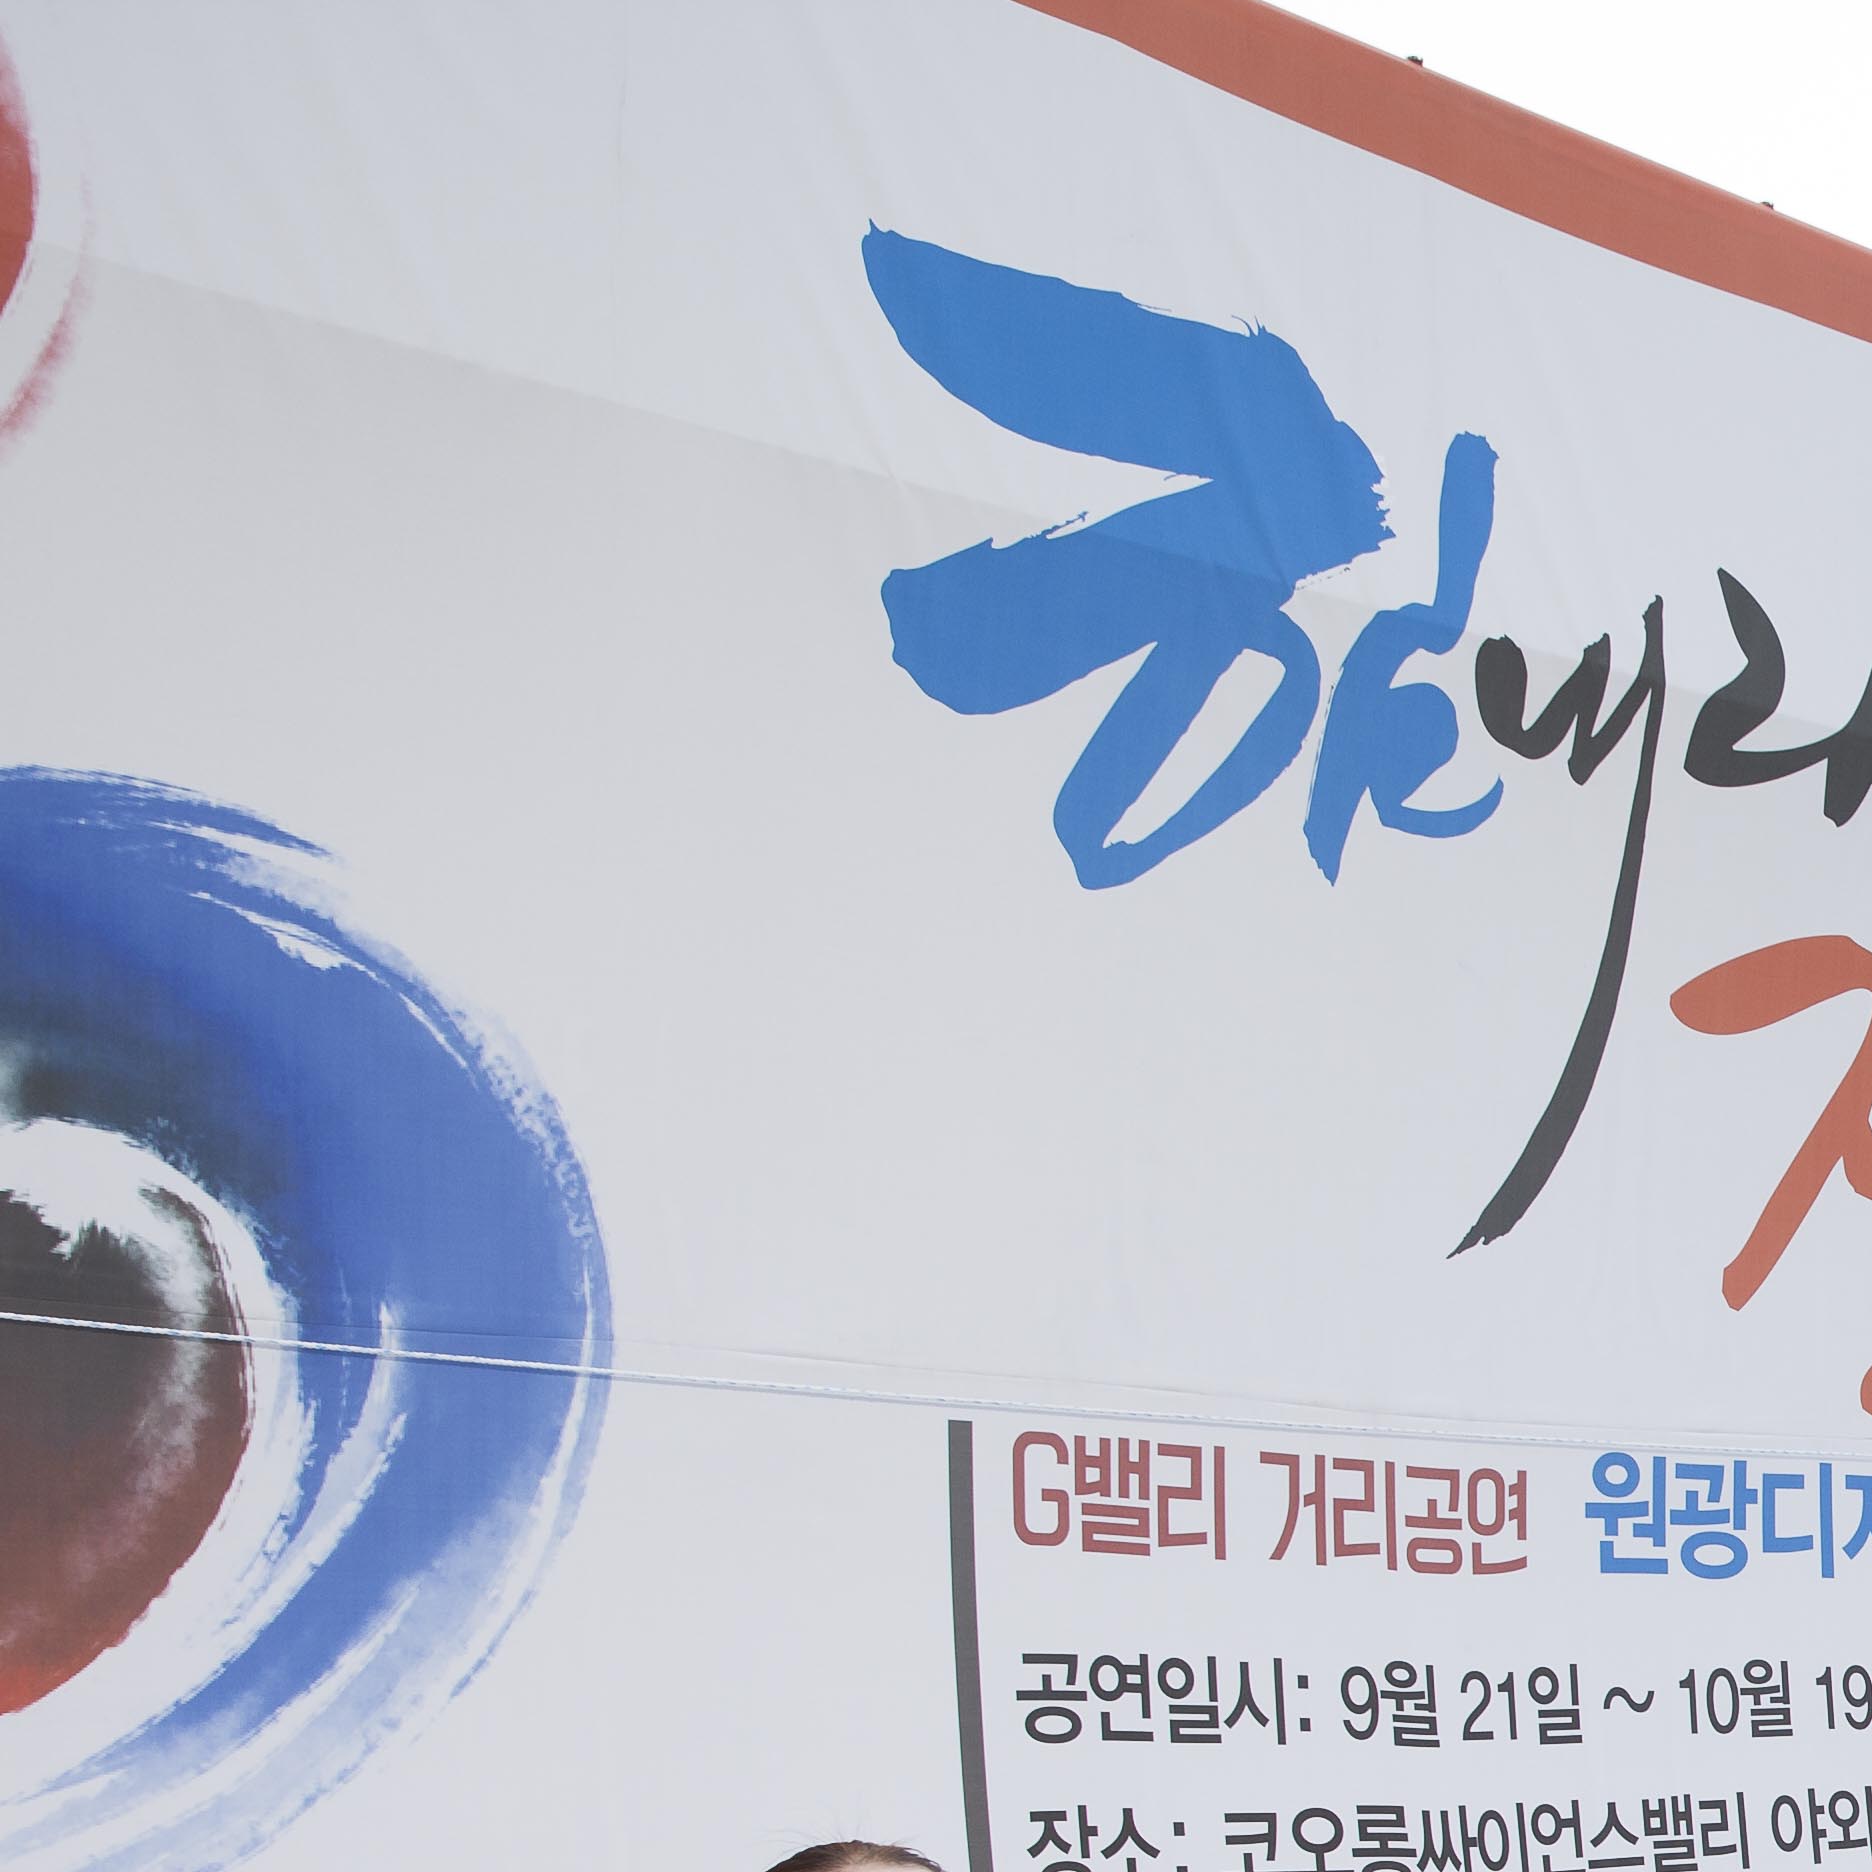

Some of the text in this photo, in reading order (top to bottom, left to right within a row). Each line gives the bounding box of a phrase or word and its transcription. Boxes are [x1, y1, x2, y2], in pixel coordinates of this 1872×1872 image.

[1012, 1429, 1228, 1561] G밸리
[1258, 1450, 1528, 1576] 거리공연
[1014, 1652, 1312, 1745] 공연일시:
[1339, 1658, 1441, 1748] 9월
[1460, 1662, 1584, 1745] 21일
[1677, 1658, 1794, 1739] 10월
